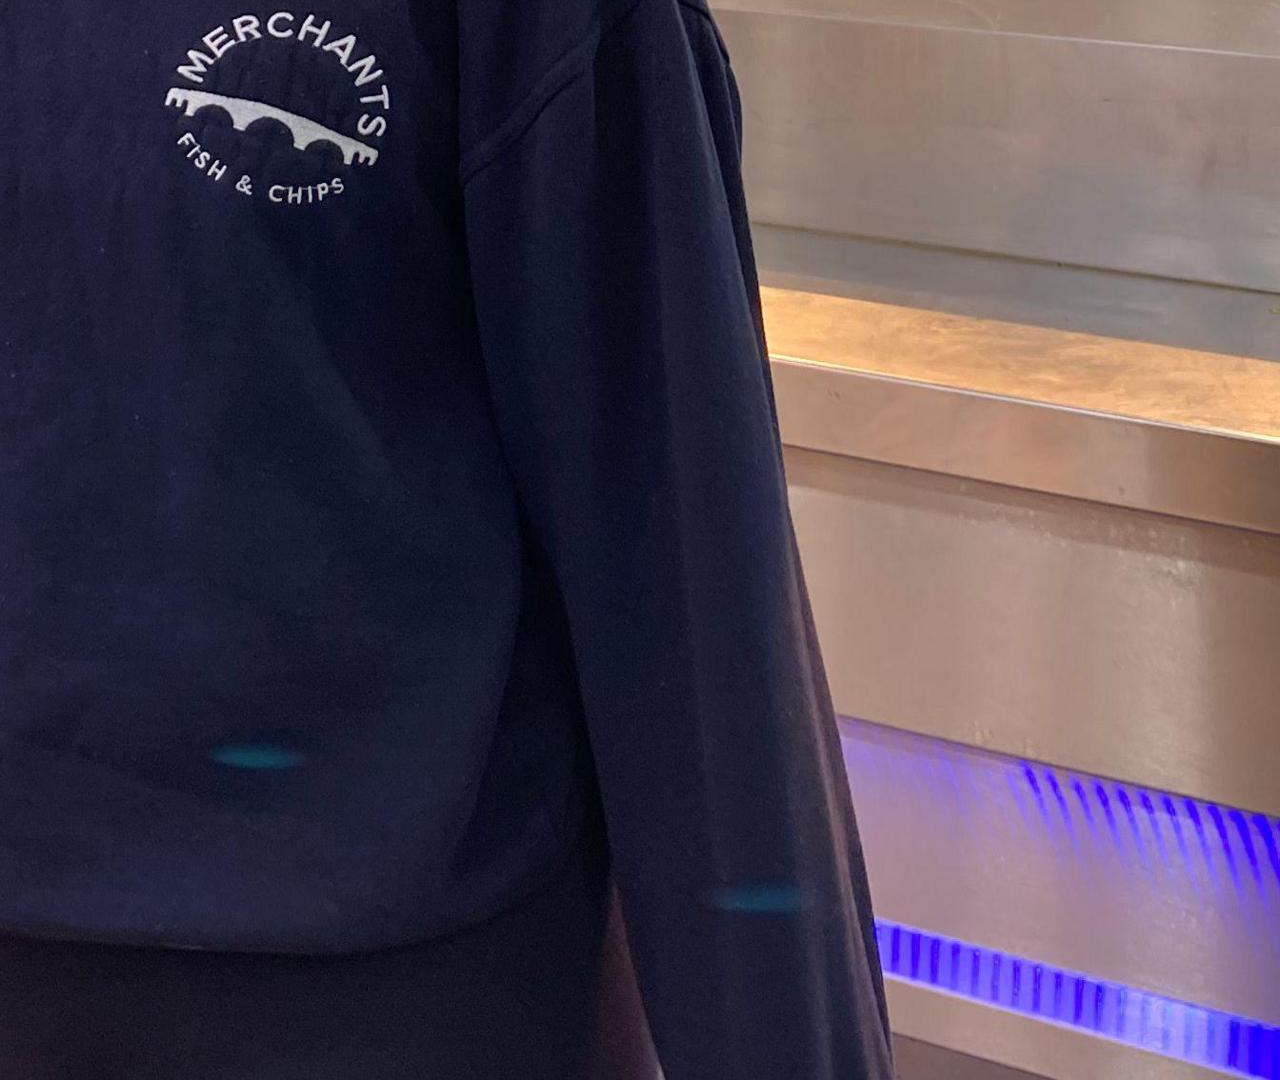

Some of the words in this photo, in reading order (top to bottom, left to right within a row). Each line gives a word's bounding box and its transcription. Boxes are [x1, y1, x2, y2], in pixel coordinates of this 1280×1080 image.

[176, 11, 390, 138] MERCHANTS
[177, 132, 228, 181] FISH
[235, 174, 253, 195] &
[268, 177, 345, 205] CHIPS
